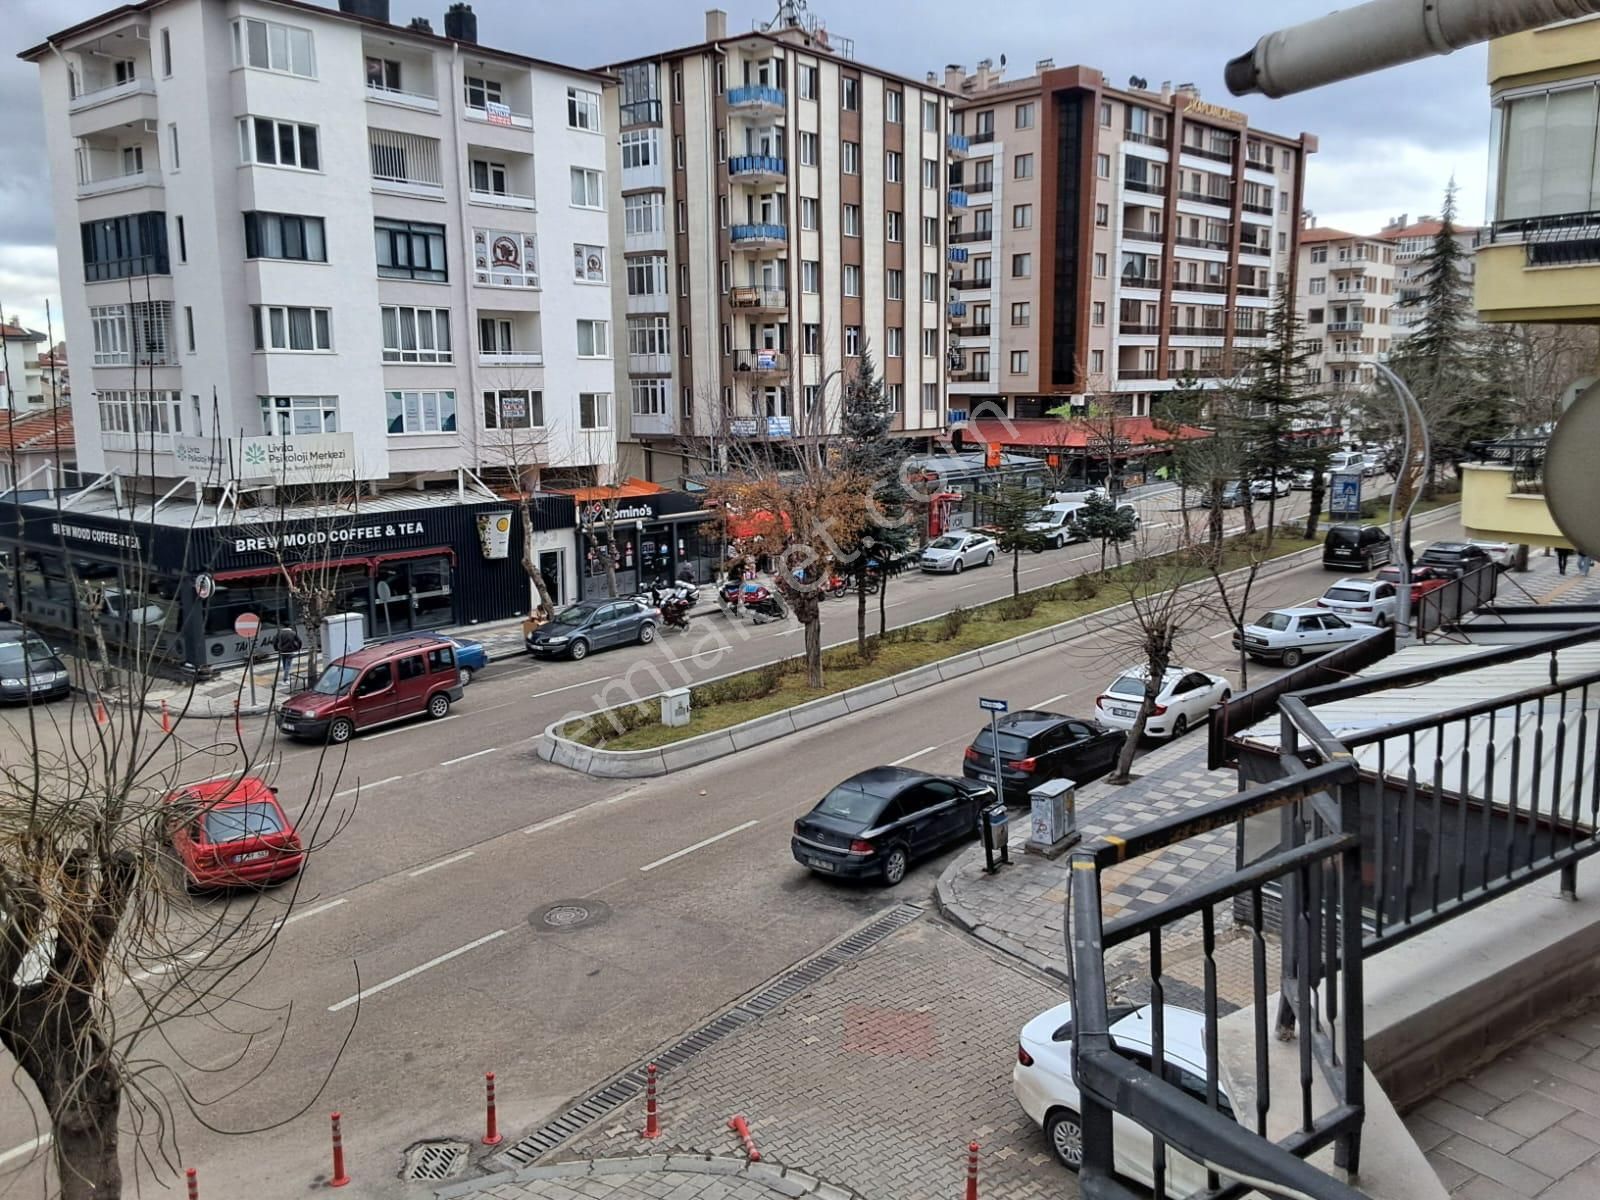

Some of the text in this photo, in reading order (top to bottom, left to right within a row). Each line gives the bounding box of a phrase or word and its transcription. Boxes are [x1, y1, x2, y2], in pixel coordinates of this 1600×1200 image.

[91, 529, 118, 546] COFFEE
[235, 522, 425, 552] BREW MOOD COFFEE & TEA
